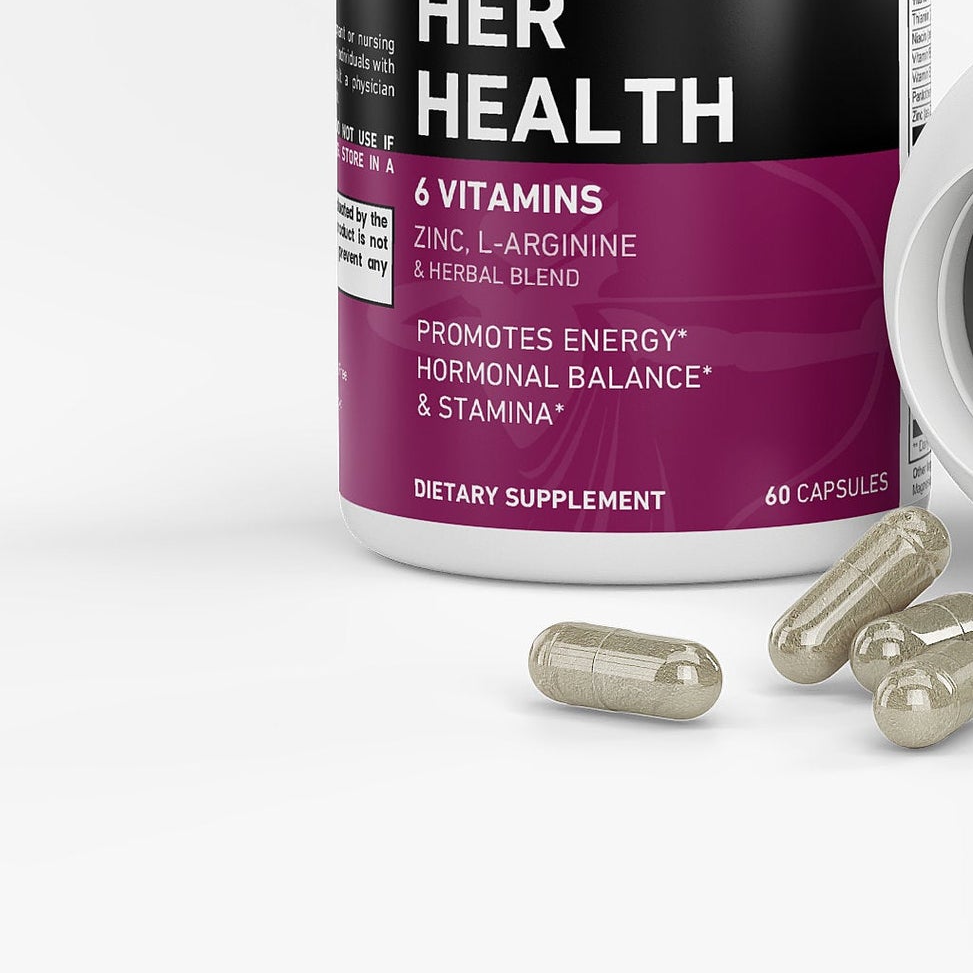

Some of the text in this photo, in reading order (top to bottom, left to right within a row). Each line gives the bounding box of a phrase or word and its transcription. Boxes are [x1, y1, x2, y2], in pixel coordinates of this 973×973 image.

[358, 33, 395, 55] nursing
[372, 56, 395, 74] with
[352, 75, 395, 97] physician
[417, 69, 735, 145] HEALTH
[342, 123, 354, 143] NOT
[358, 130, 378, 149] USE
[383, 134, 394, 151] IF
[342, 145, 364, 169] STORE
[369, 154, 380, 172] IN
[385, 158, 394, 174] A
[414, 177, 604, 215] 6 VITAMINS
[356, 207, 367, 229] by
[370, 211, 388, 229] the
[358, 228, 366, 245] is
[370, 235, 388, 251] not
[413, 225, 637, 258] ZINC, L-ARGININE
[368, 257, 388, 277] any
[413, 259, 580, 287] & HERBAL BLEND
[417, 319, 553, 351] PROMOTES
[417, 357, 559, 389] HORMONAL
[417, 393, 432, 417] &
[414, 478, 666, 511] DIETARY SUPPLEMENT
[765, 471, 889, 506] 60 CAPSULES
